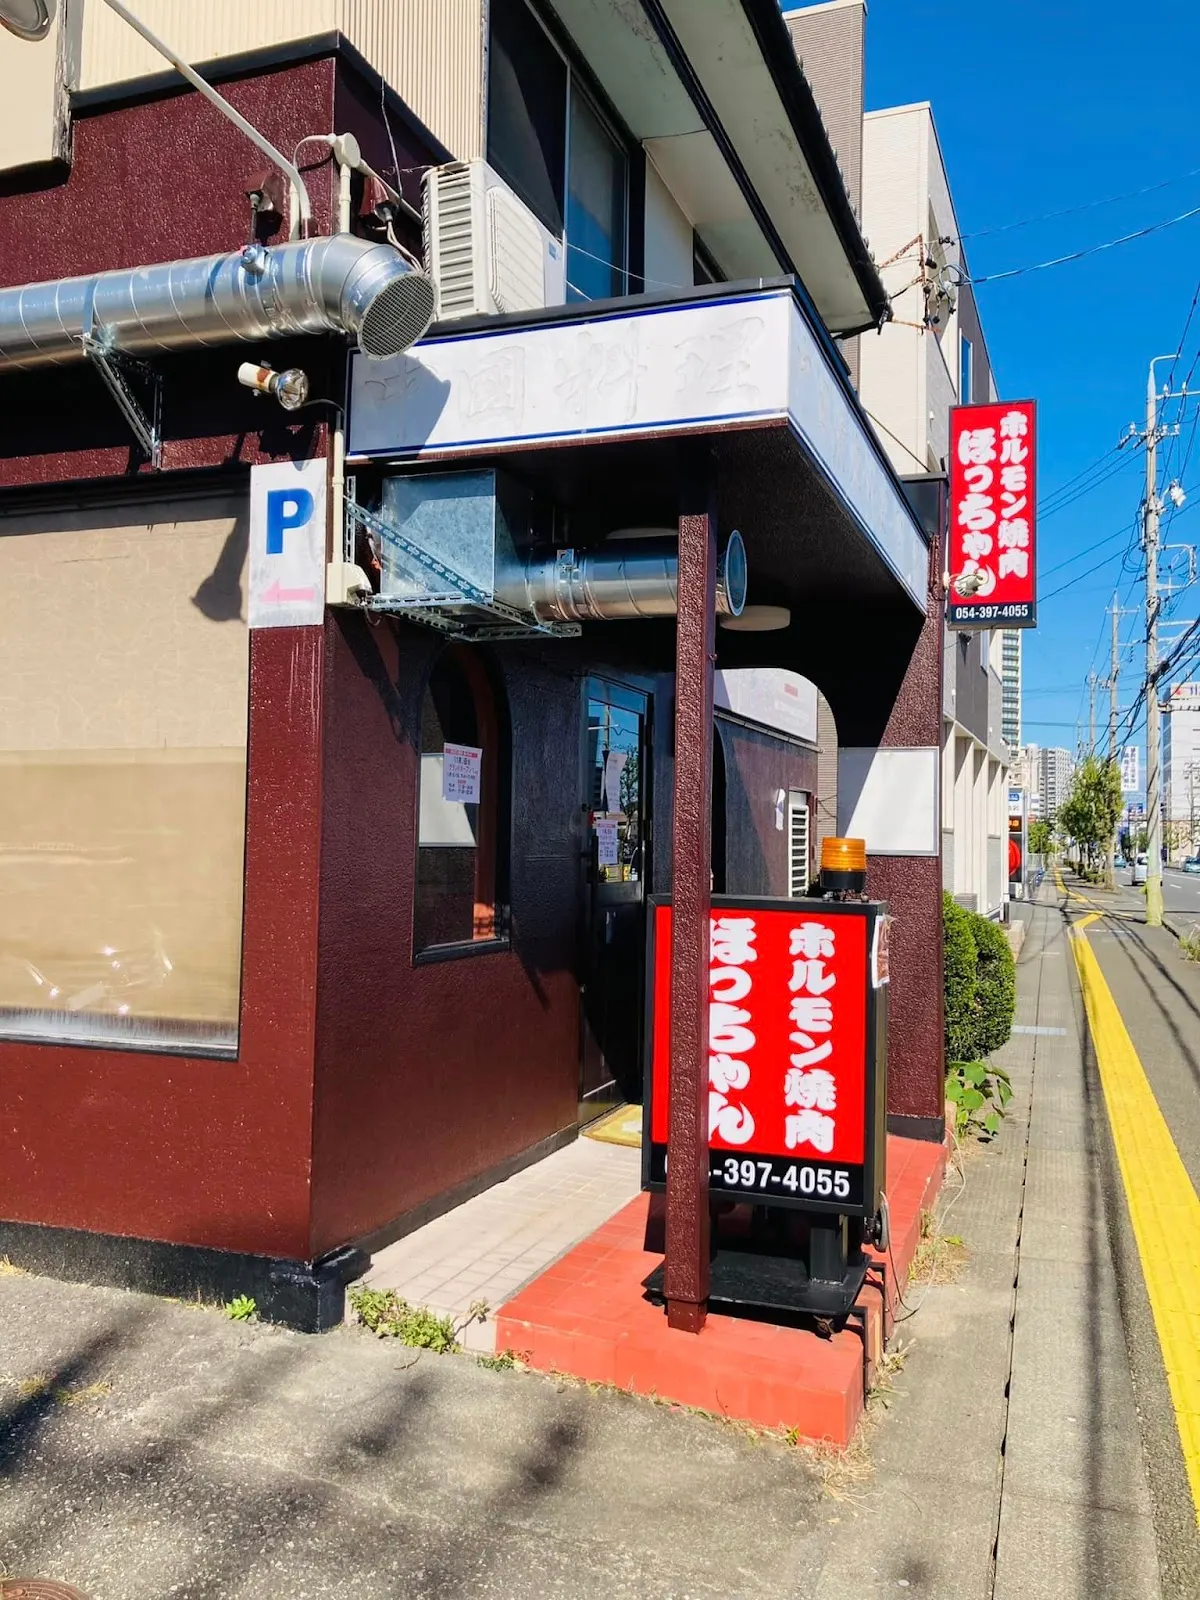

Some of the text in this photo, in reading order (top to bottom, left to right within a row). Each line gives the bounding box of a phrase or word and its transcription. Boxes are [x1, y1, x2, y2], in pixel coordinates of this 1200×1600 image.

[266, 488, 314, 555] P
[998, 411, 1029, 578] ホルモン焼肉
[955, 605, 1030, 620] 054-397-4055
[784, 922, 837, 1153] ホルモン焼肉
